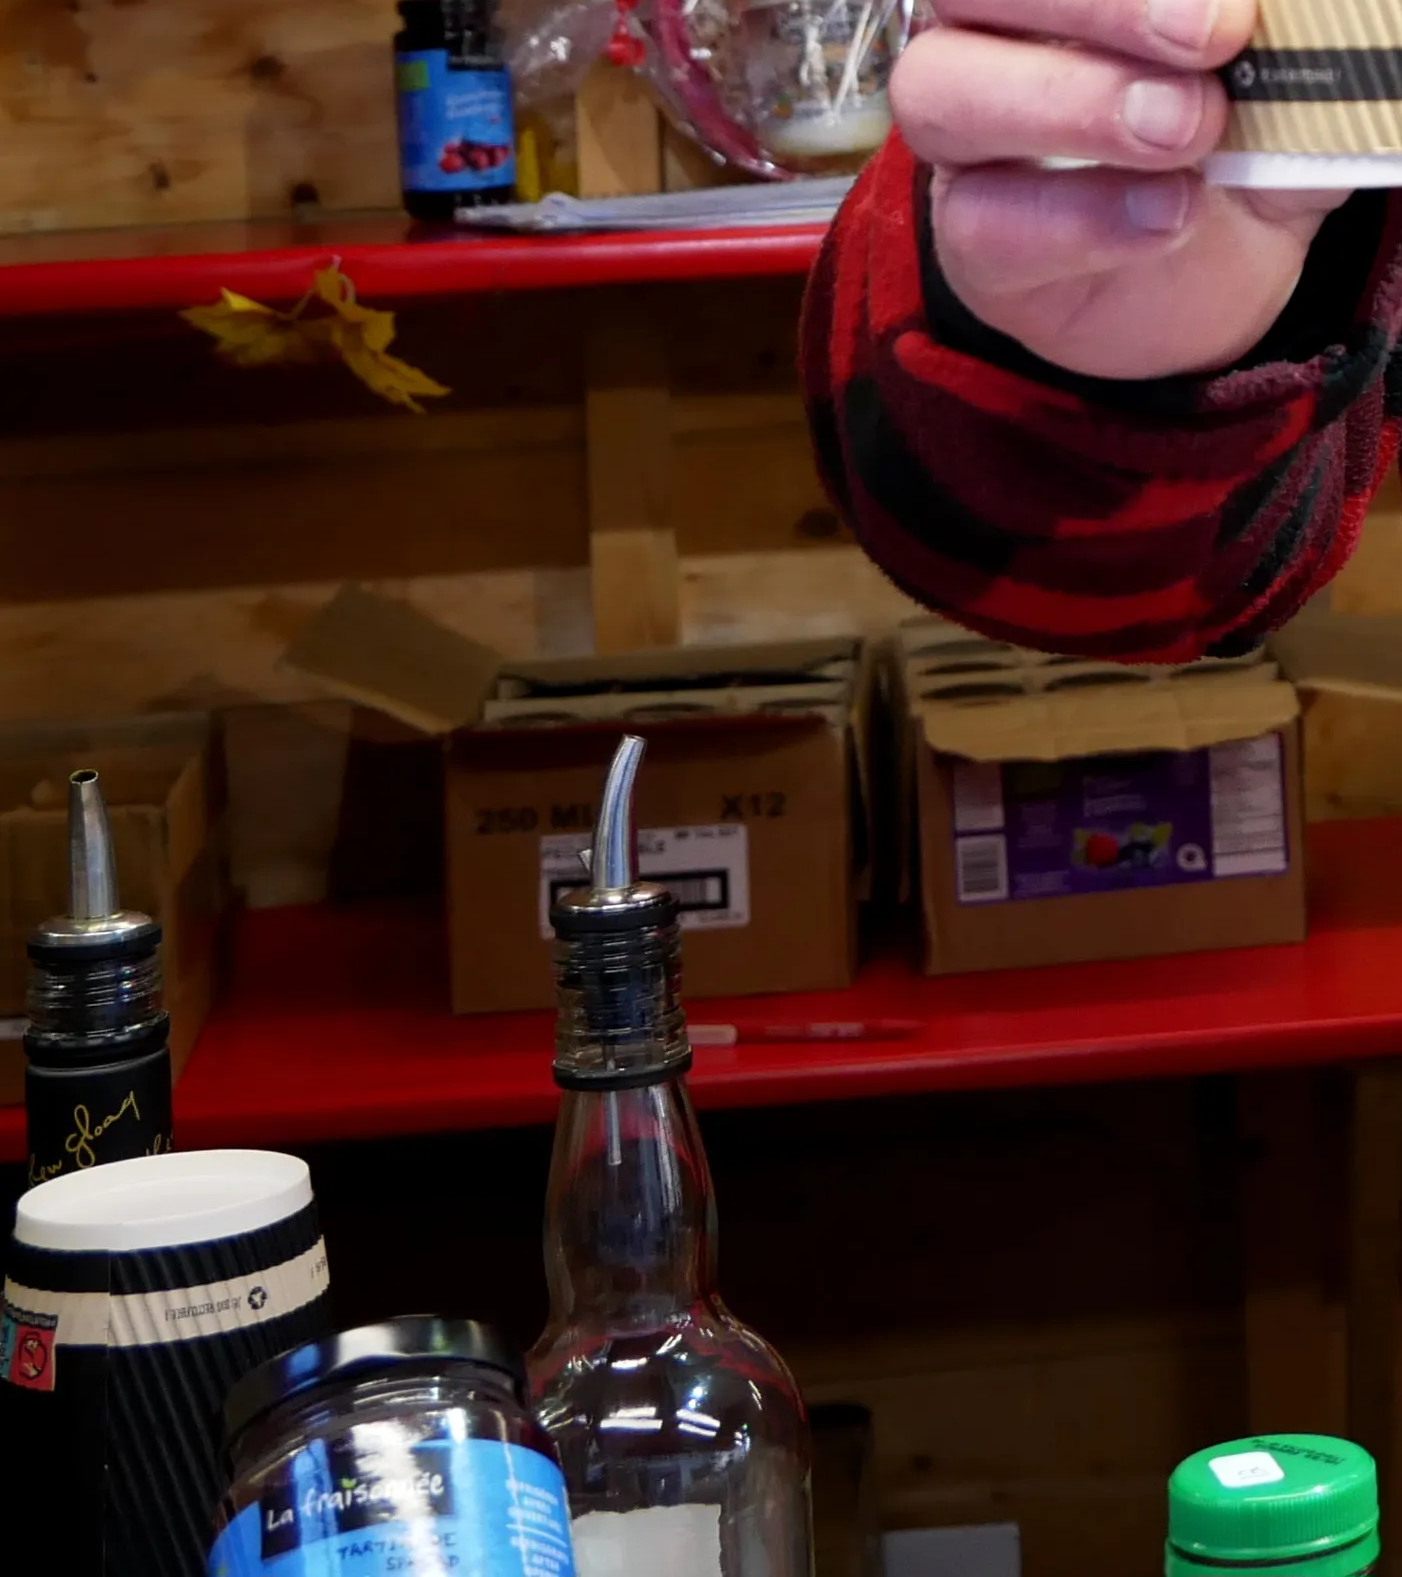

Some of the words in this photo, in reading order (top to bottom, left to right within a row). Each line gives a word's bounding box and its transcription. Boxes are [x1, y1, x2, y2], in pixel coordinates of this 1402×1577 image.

[476, 806, 538, 835] 250
[721, 792, 786, 820] X12
[267, 1508, 294, 1531] La
